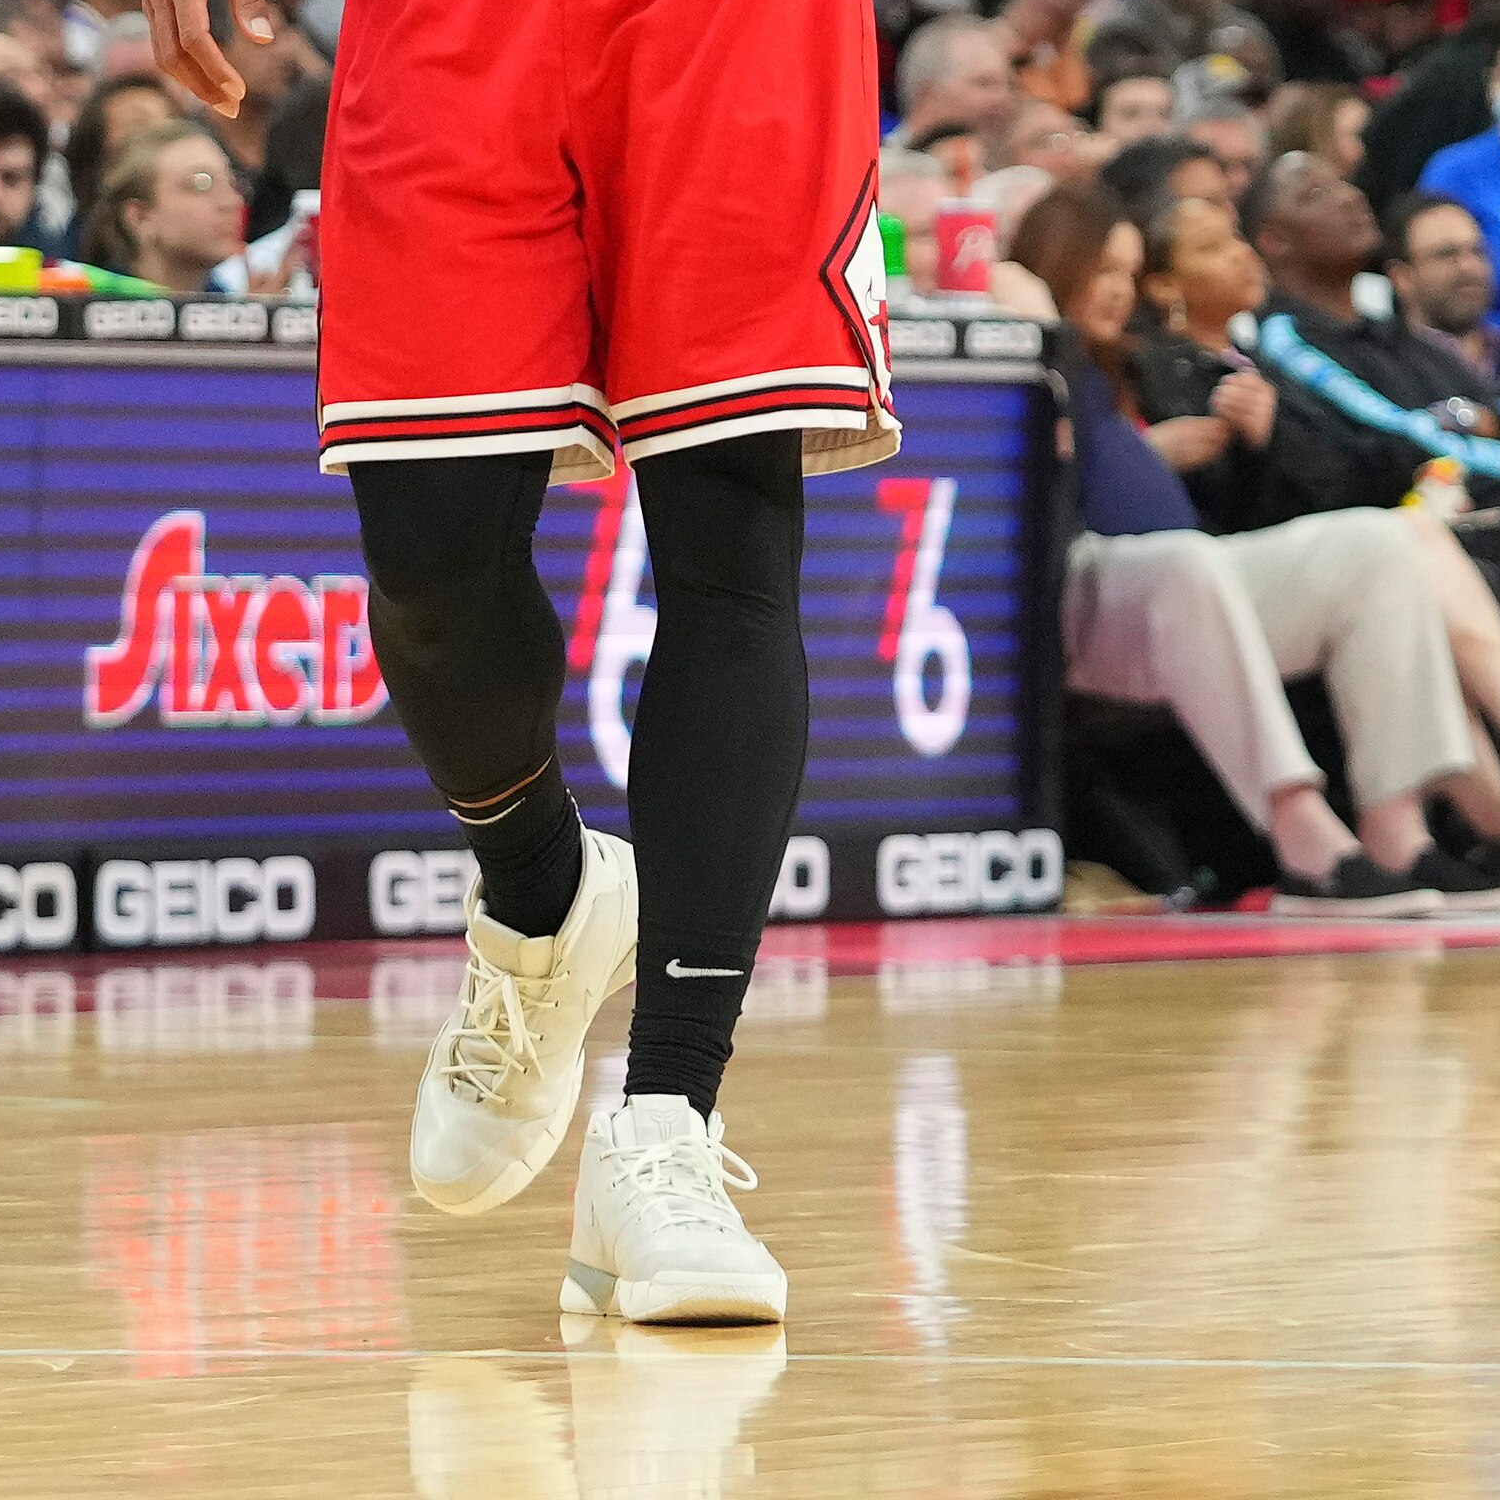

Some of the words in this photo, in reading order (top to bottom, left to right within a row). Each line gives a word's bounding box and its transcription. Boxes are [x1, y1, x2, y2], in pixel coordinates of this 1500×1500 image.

[84, 300, 176, 339] GEICO
[178, 302, 268, 342] GEICO
[94, 854, 315, 948] GEICO
[877, 828, 1065, 916] GEICO
